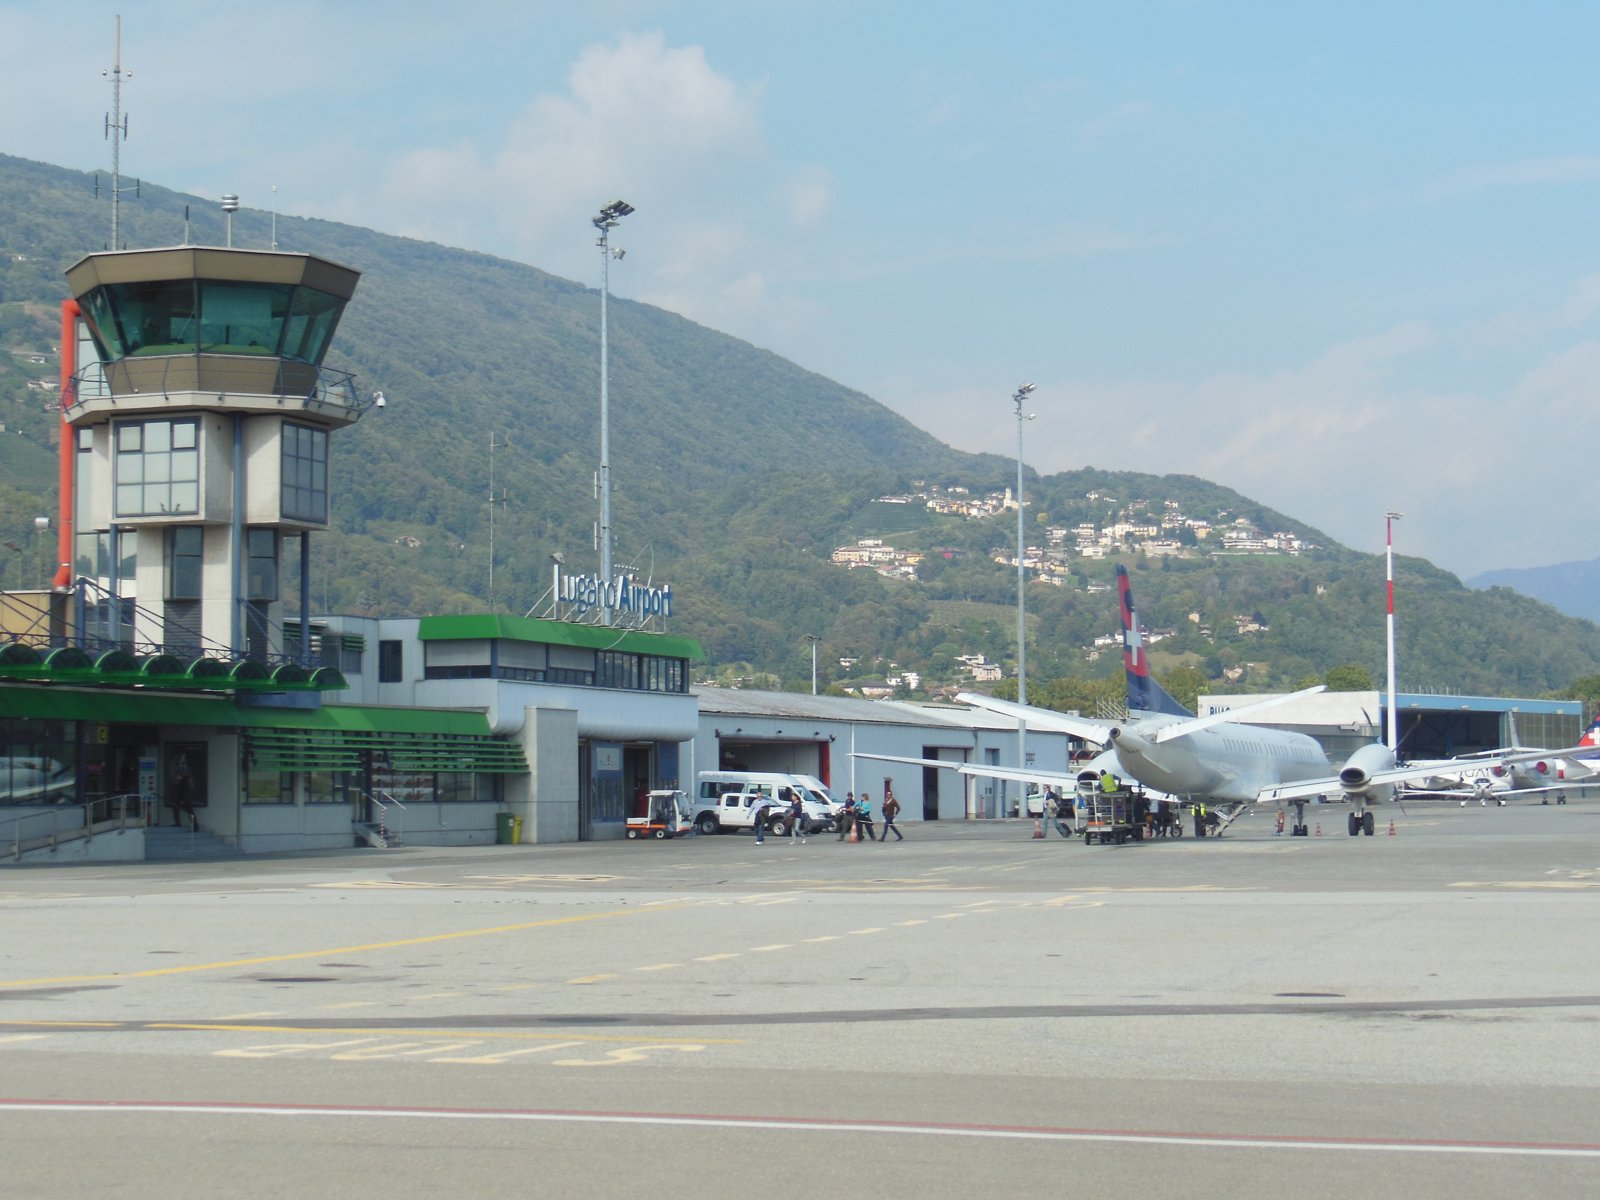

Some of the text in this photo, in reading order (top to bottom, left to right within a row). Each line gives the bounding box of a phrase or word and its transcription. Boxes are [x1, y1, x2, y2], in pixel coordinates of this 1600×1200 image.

[554, 565, 673, 621] Lugano Airport
[212, 1038, 706, 1066] STOP
